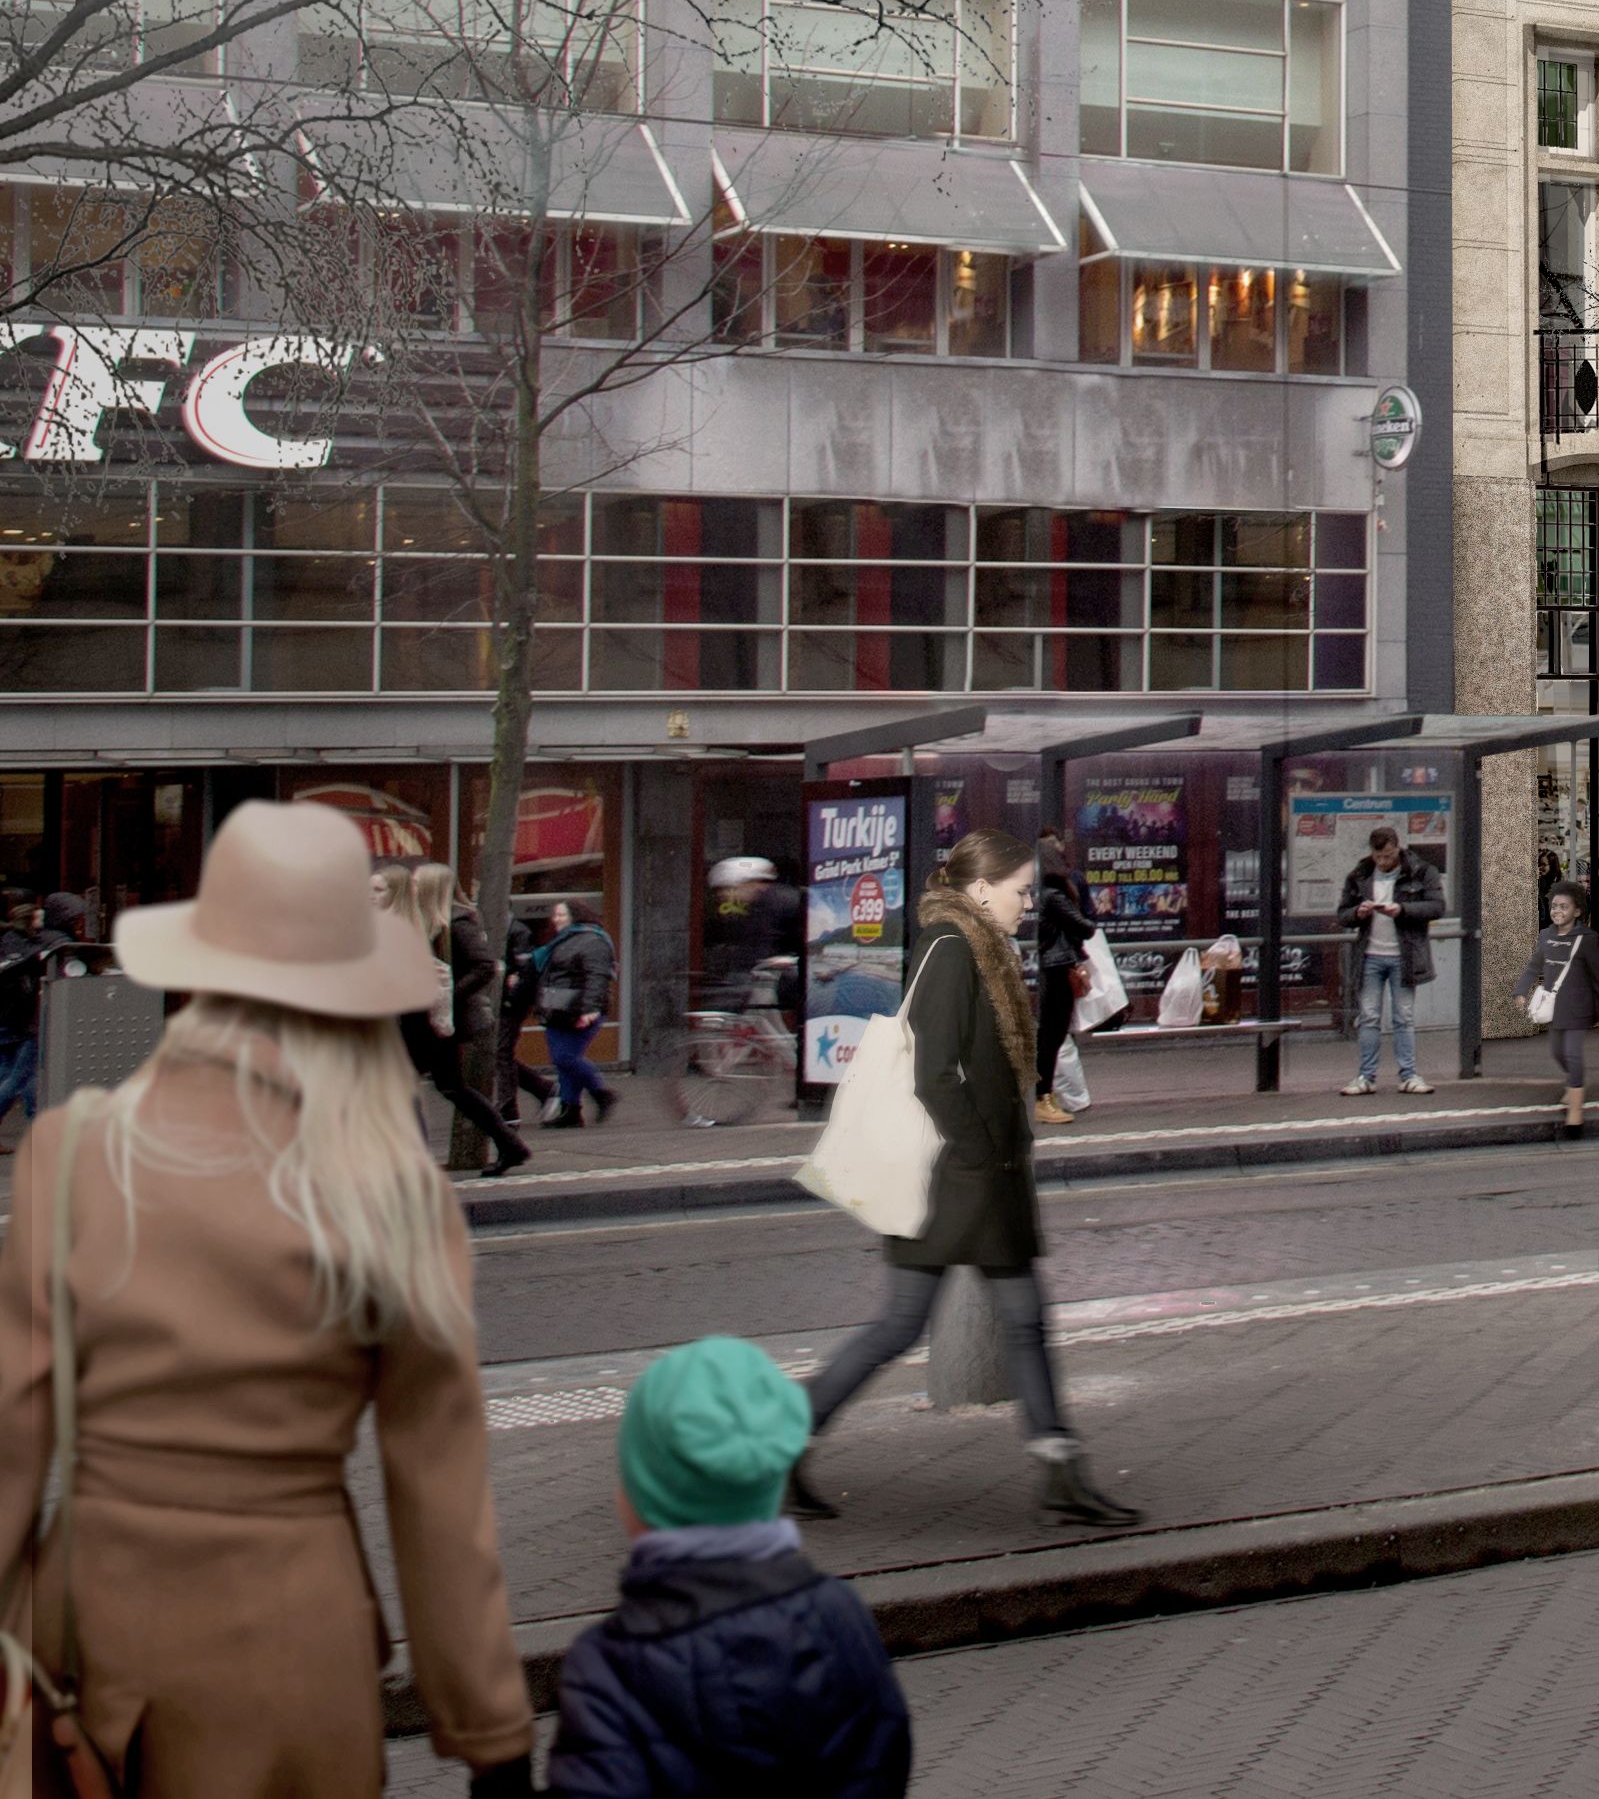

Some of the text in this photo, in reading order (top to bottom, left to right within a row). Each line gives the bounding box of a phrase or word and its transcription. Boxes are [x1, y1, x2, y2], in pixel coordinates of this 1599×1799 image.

[1087, 789, 1132, 809] Party
[1343, 797, 1393, 810] Centrum
[820, 804, 898, 857] Turkije
[1088, 844, 1179, 862] EVERY WEEKEND
[852, 897, 885, 922] €399
